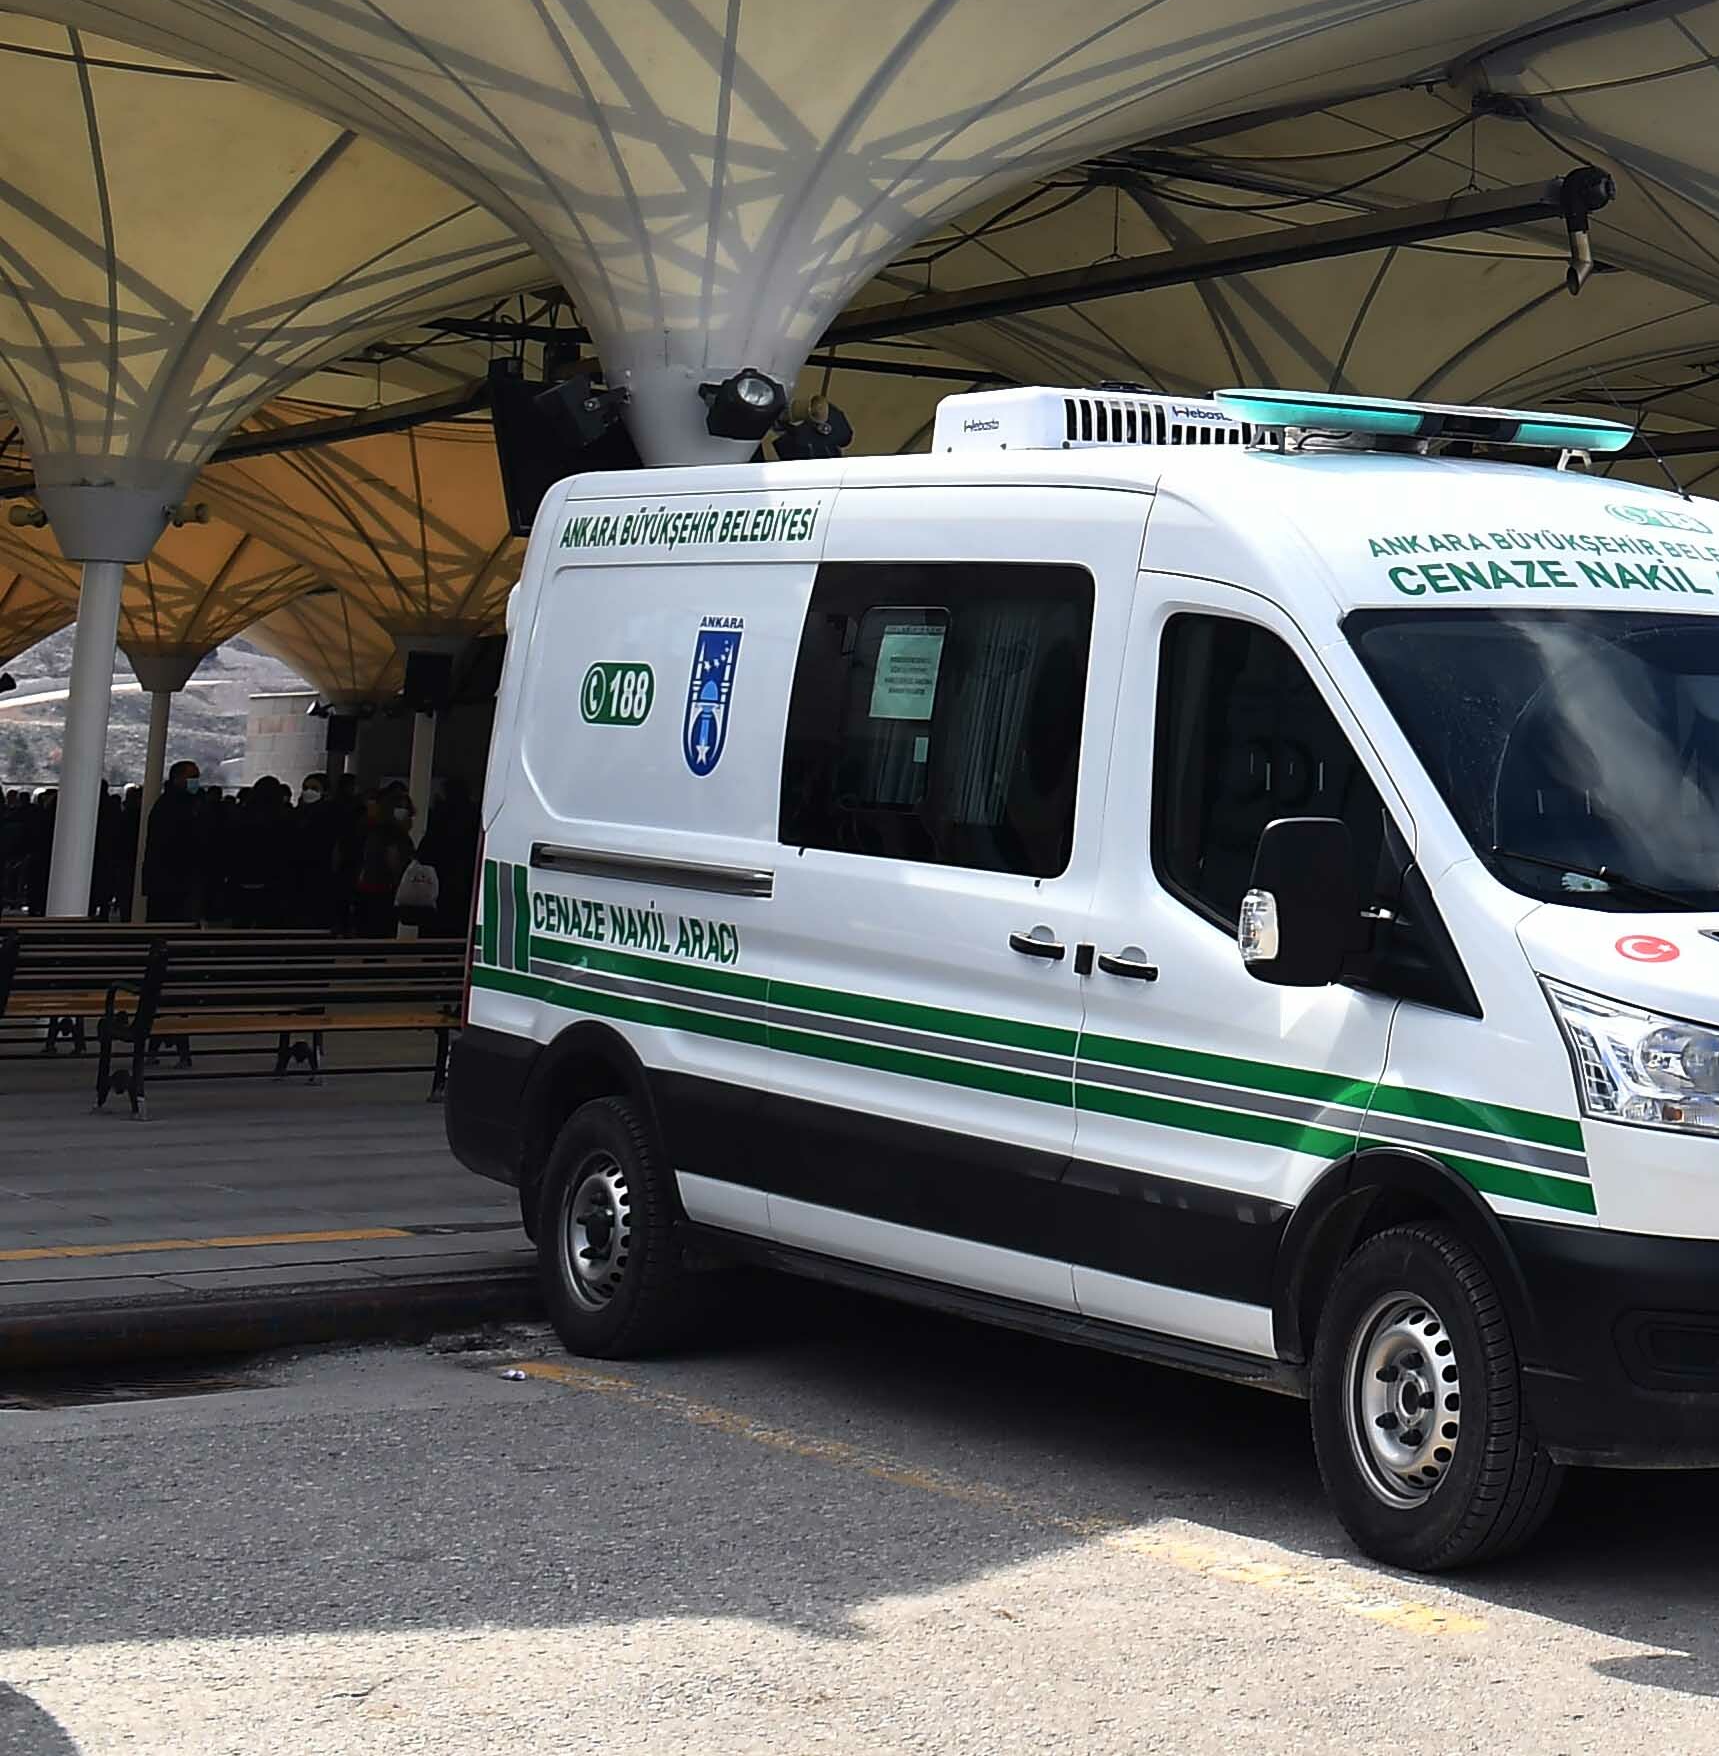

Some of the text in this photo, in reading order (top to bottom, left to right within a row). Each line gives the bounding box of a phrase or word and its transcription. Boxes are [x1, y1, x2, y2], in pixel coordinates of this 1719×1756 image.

[560, 500, 821, 550] ANKARA BÜYÜKŞEHİR BELEDİYESİ
[1368, 533, 1490, 558] ANKARA
[1496, 528, 1661, 556] BÜYÜKŞEHİR
[1388, 560, 1576, 597] CENAZE
[1577, 558, 1714, 597] NAKİL
[700, 616, 744, 629] ANKARA
[610, 670, 649, 719] 188
[533, 892, 739, 965] CENAZE NAKİL ARACI
